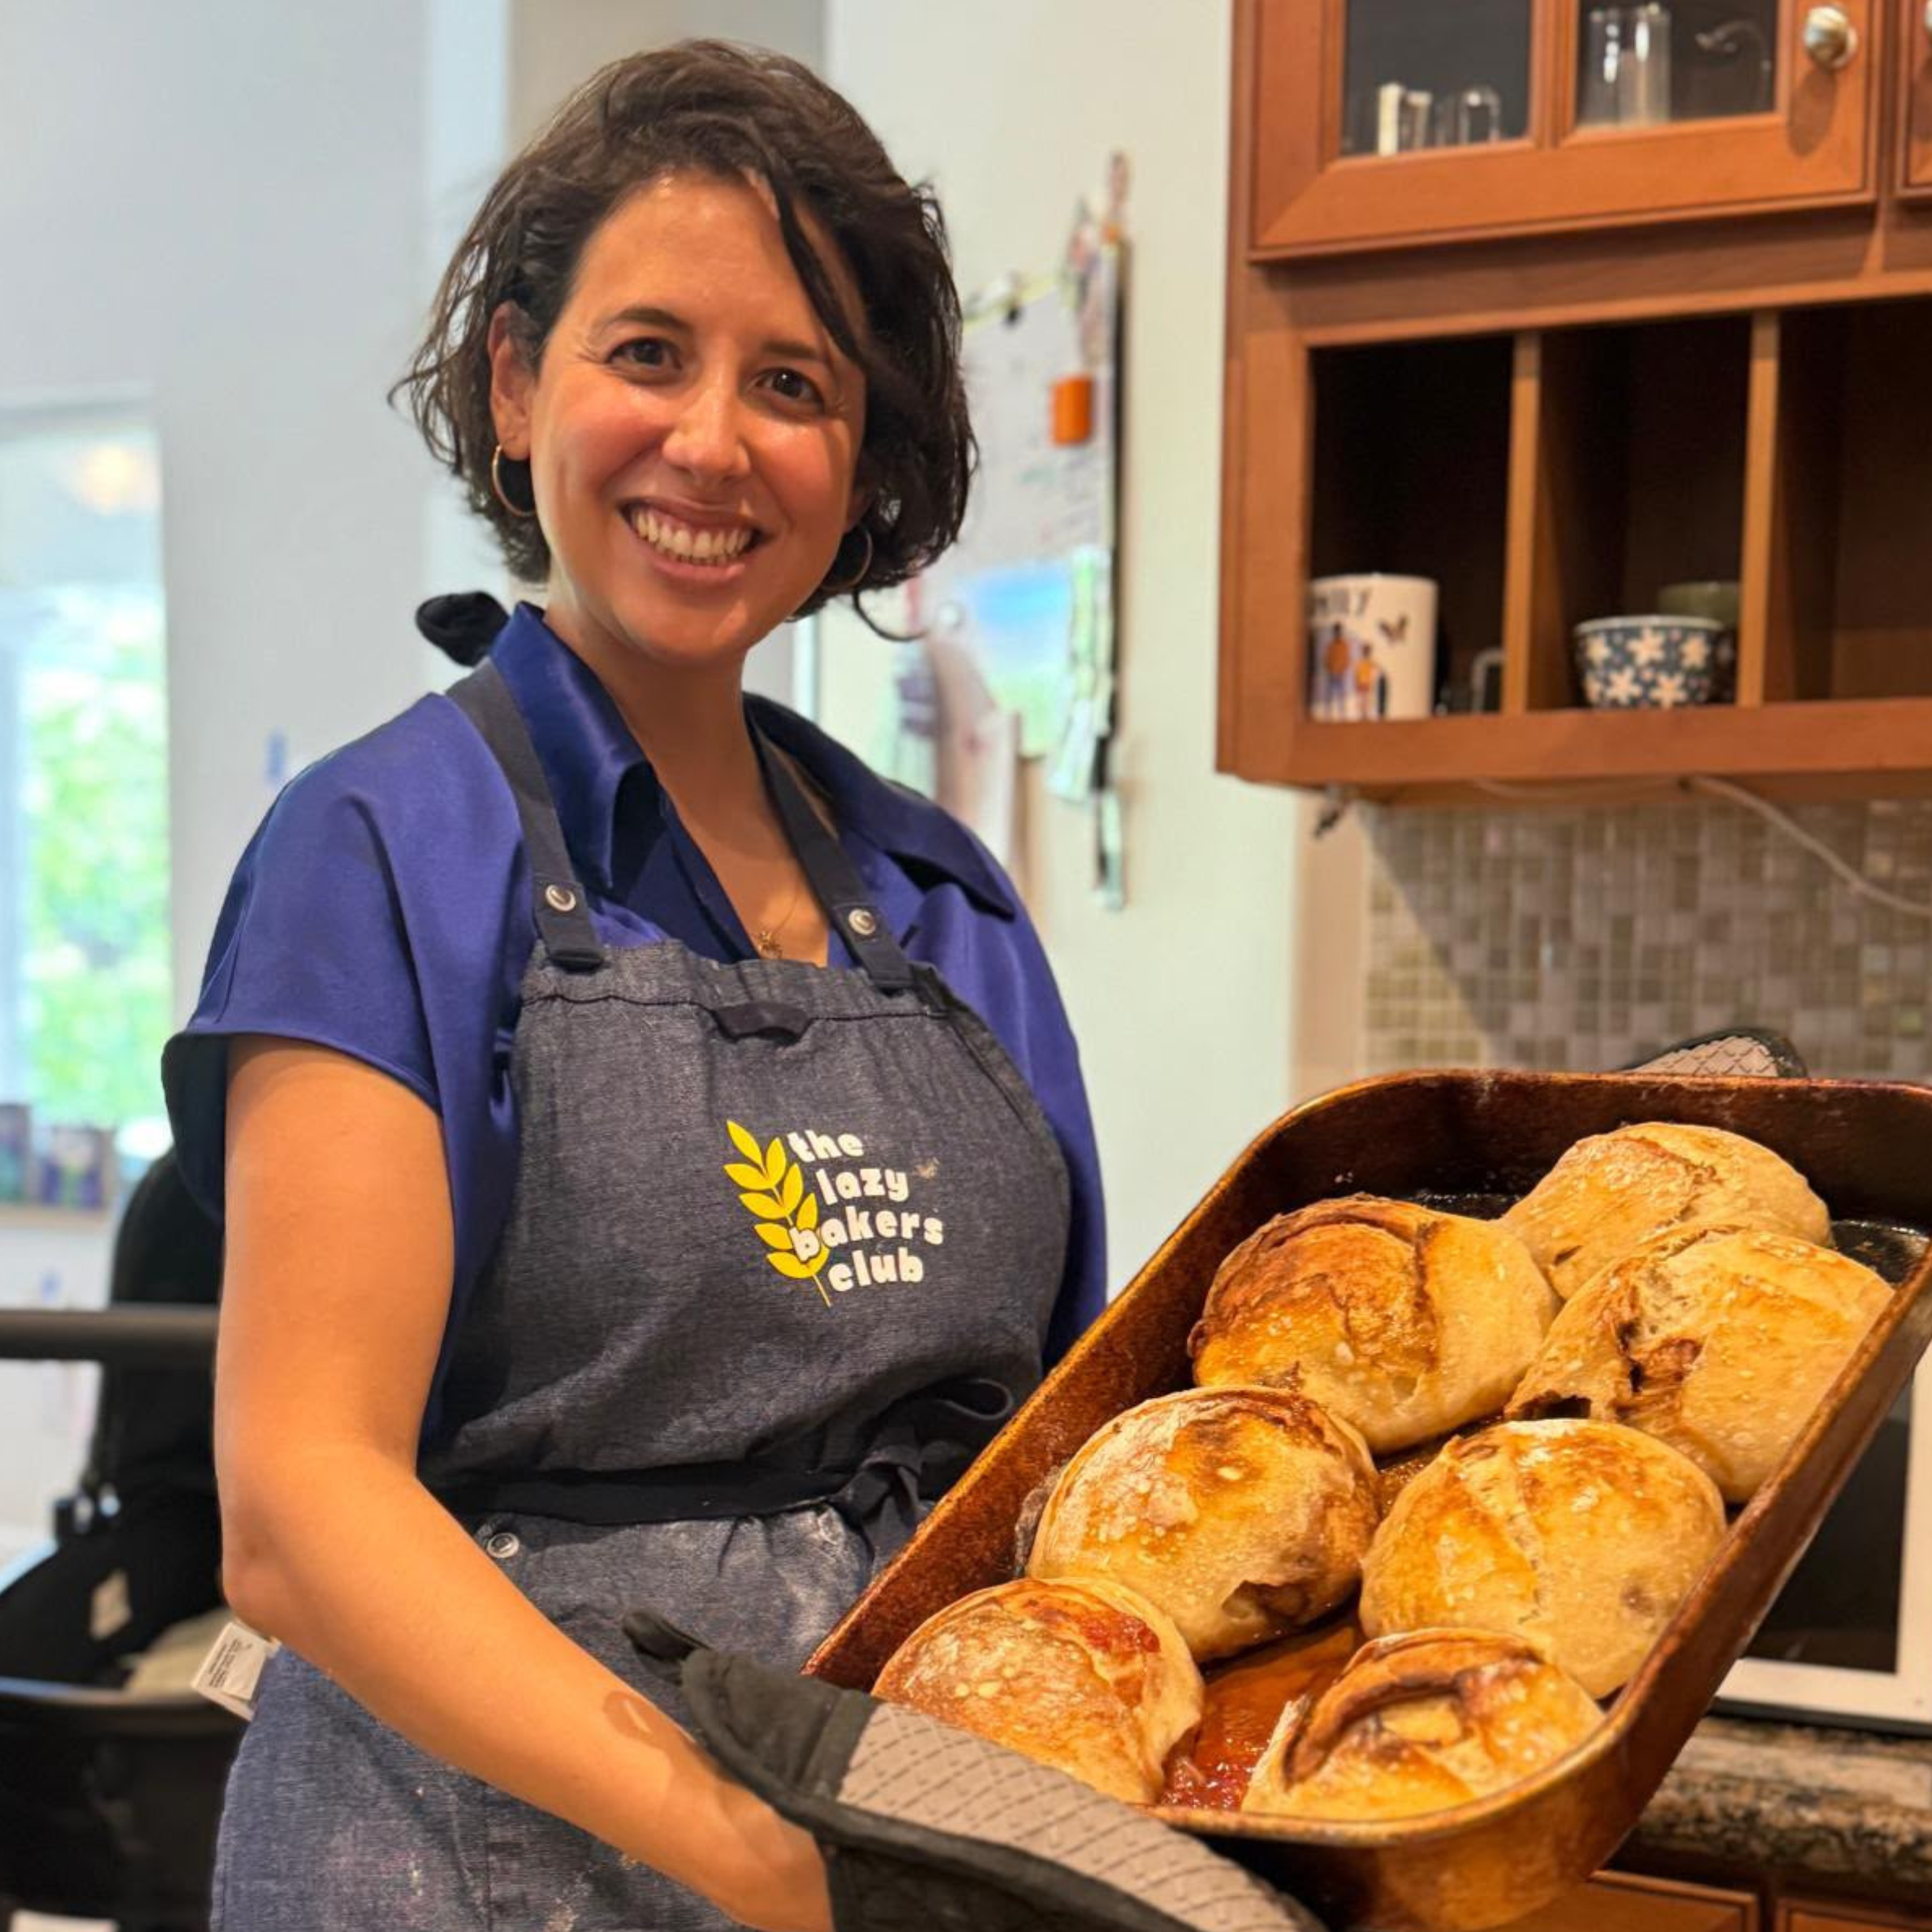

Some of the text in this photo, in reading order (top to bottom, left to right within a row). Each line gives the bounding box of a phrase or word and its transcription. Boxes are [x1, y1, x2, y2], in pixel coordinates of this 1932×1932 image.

[787, 1129, 864, 1162] the
[815, 1168, 908, 1205] lazy
[788, 1205, 943, 1261] bakers
[828, 1247, 924, 1292] club
